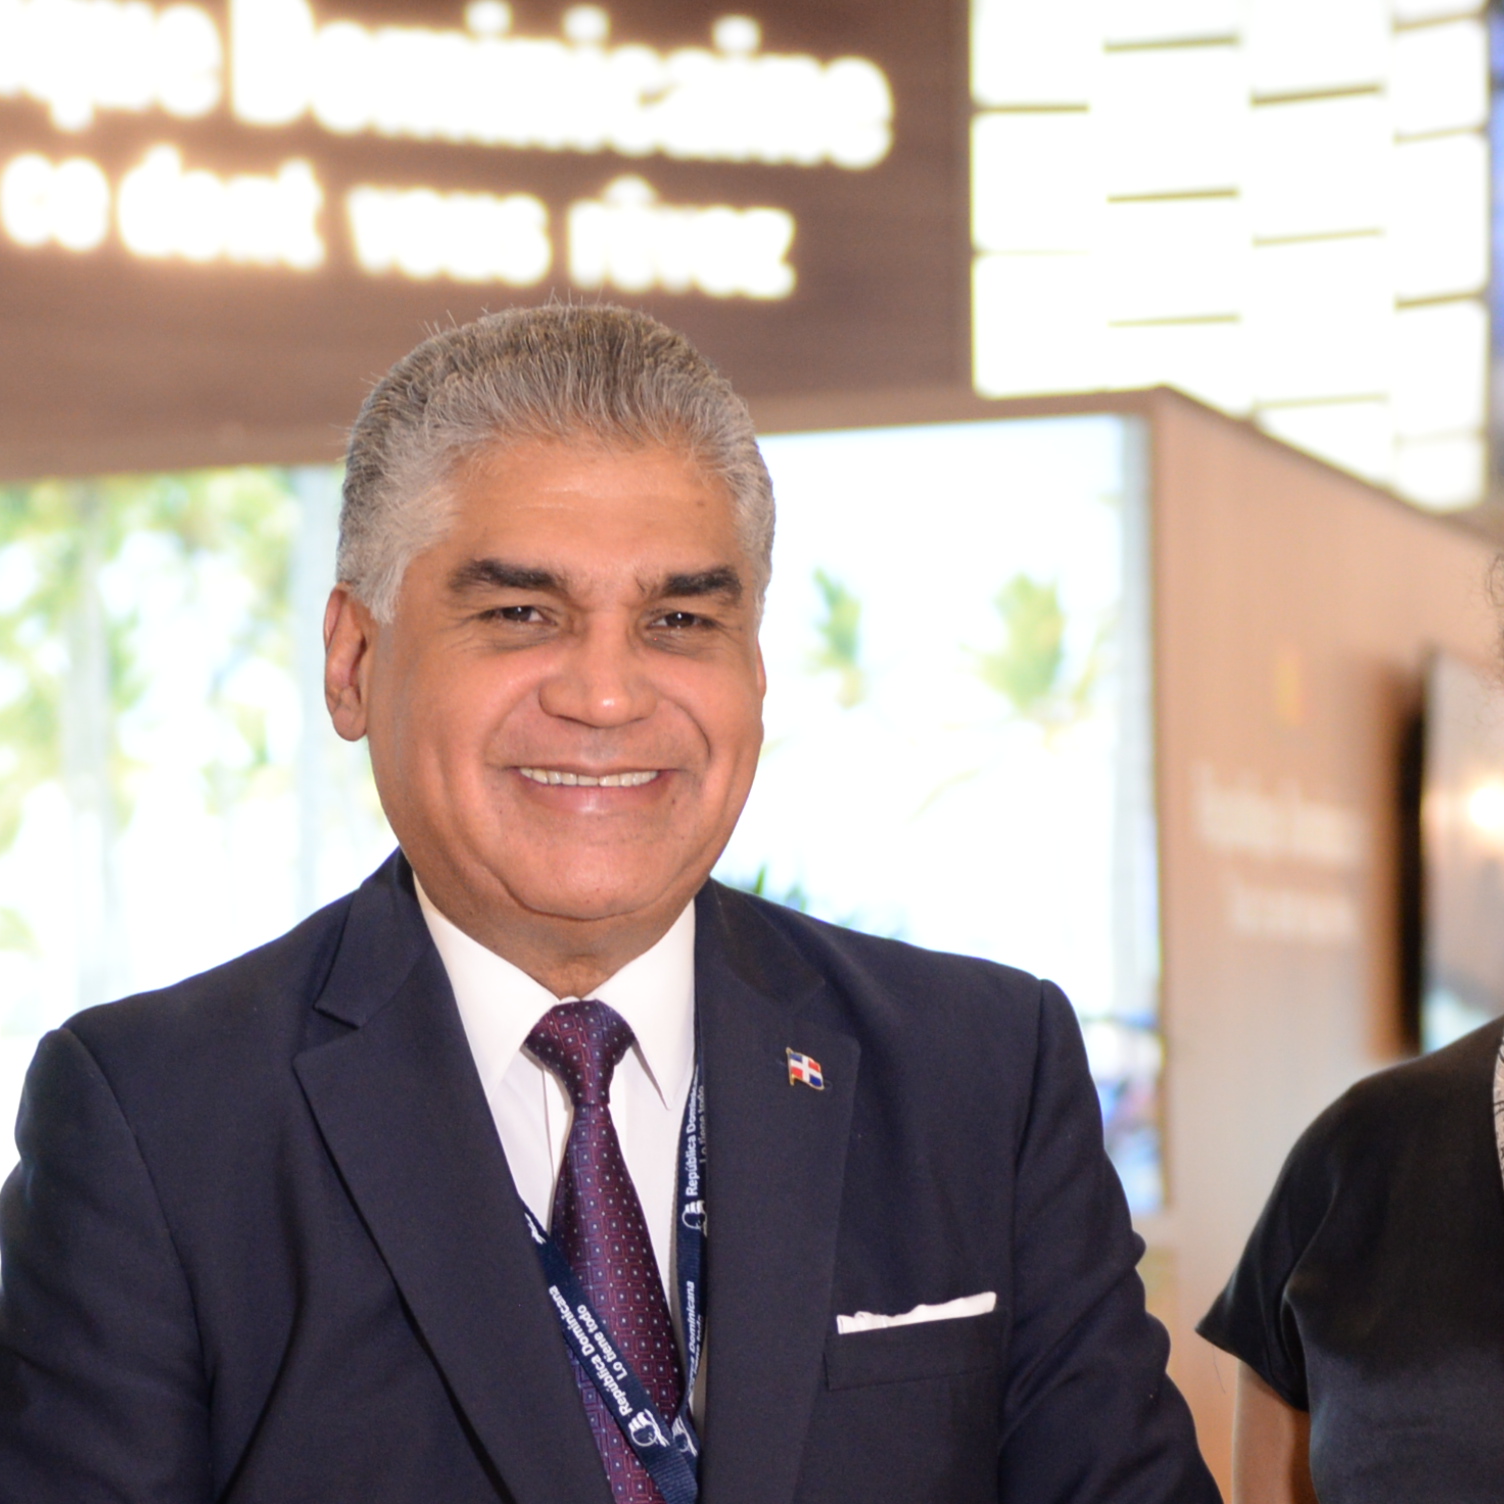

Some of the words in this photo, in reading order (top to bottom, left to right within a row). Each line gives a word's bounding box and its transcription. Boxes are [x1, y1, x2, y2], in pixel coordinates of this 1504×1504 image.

[685, 1135, 699, 1196] República
[548, 1285, 595, 1357] Dominicana
[577, 1304, 598, 1333] todo
[594, 1331, 617, 1363] tiene
[686, 1280, 696, 1355] Dominicana
[590, 1354, 633, 1417] República
[612, 1361, 629, 1381] Lo
